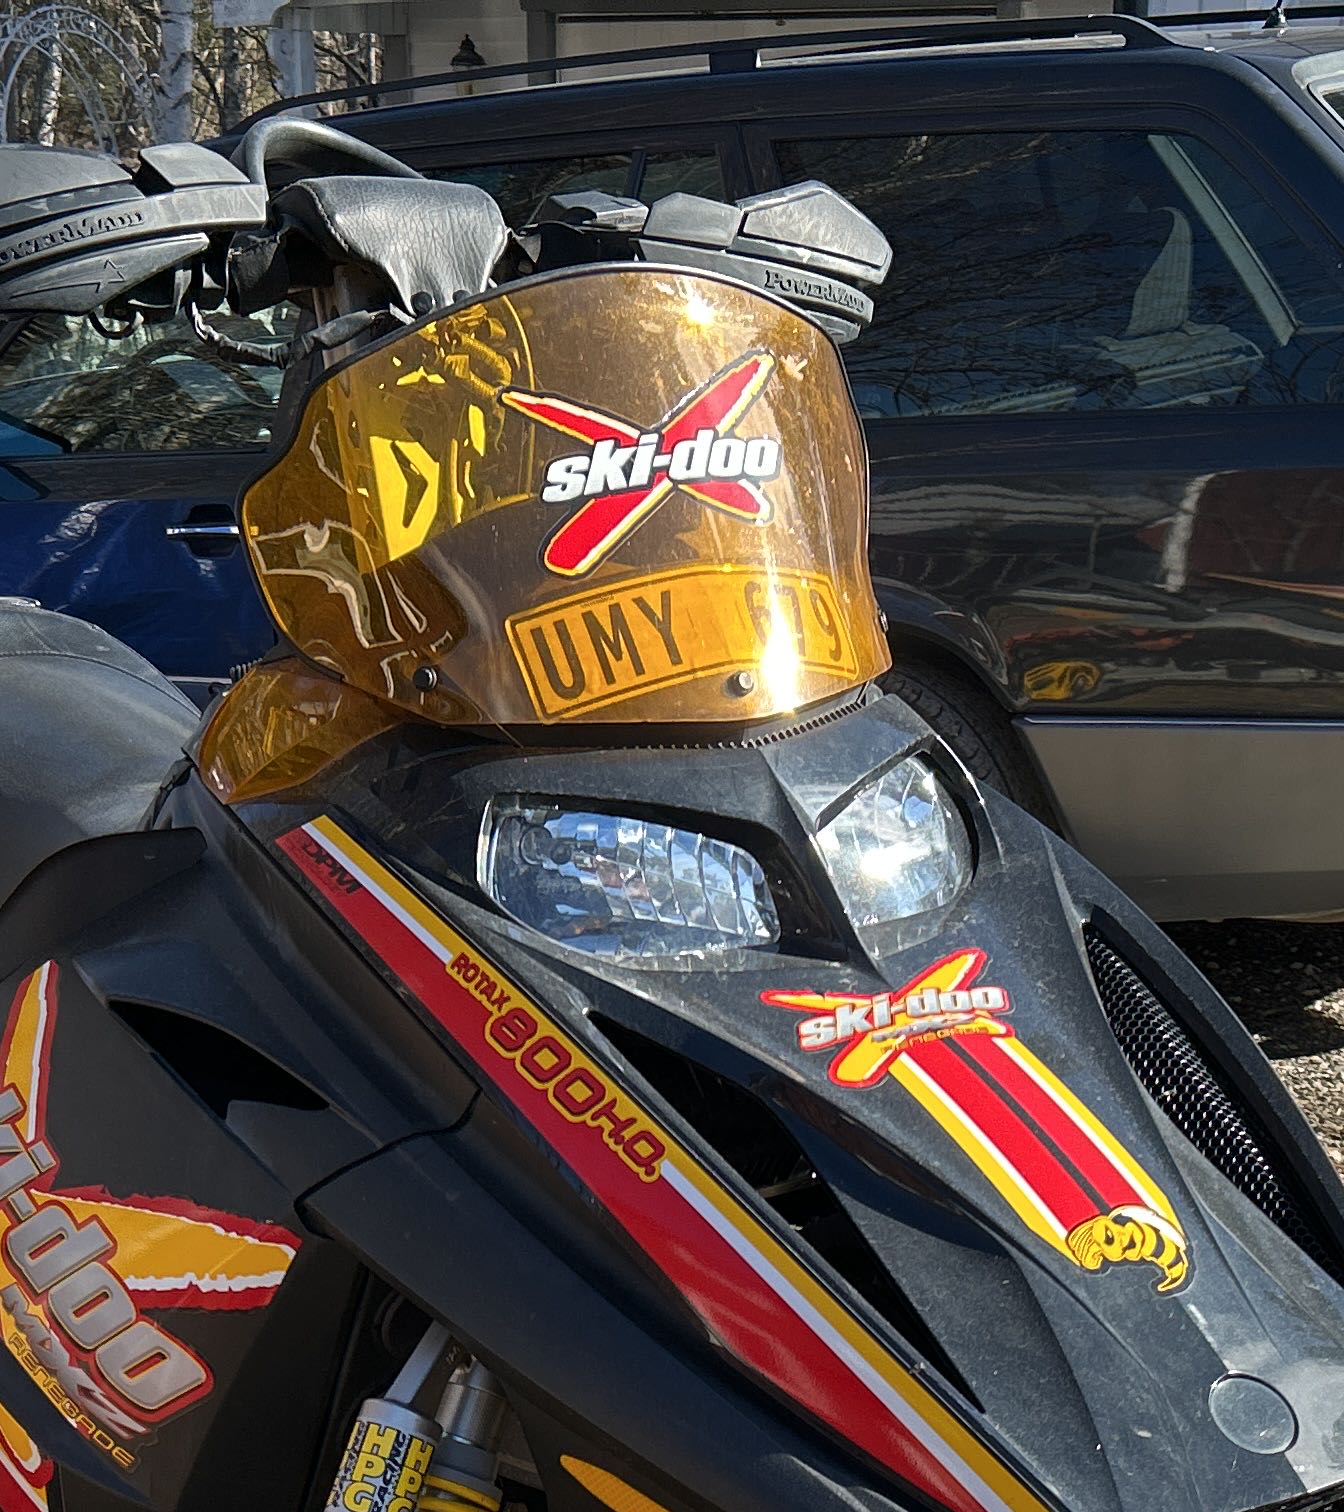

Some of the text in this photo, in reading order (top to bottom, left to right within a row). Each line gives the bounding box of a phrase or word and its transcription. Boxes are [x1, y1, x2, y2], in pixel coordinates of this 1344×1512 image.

[530, 590, 683, 700] UMY
[450, 952, 511, 1011] ROTAX
[9, 1332, 136, 1468] RENEGADE
